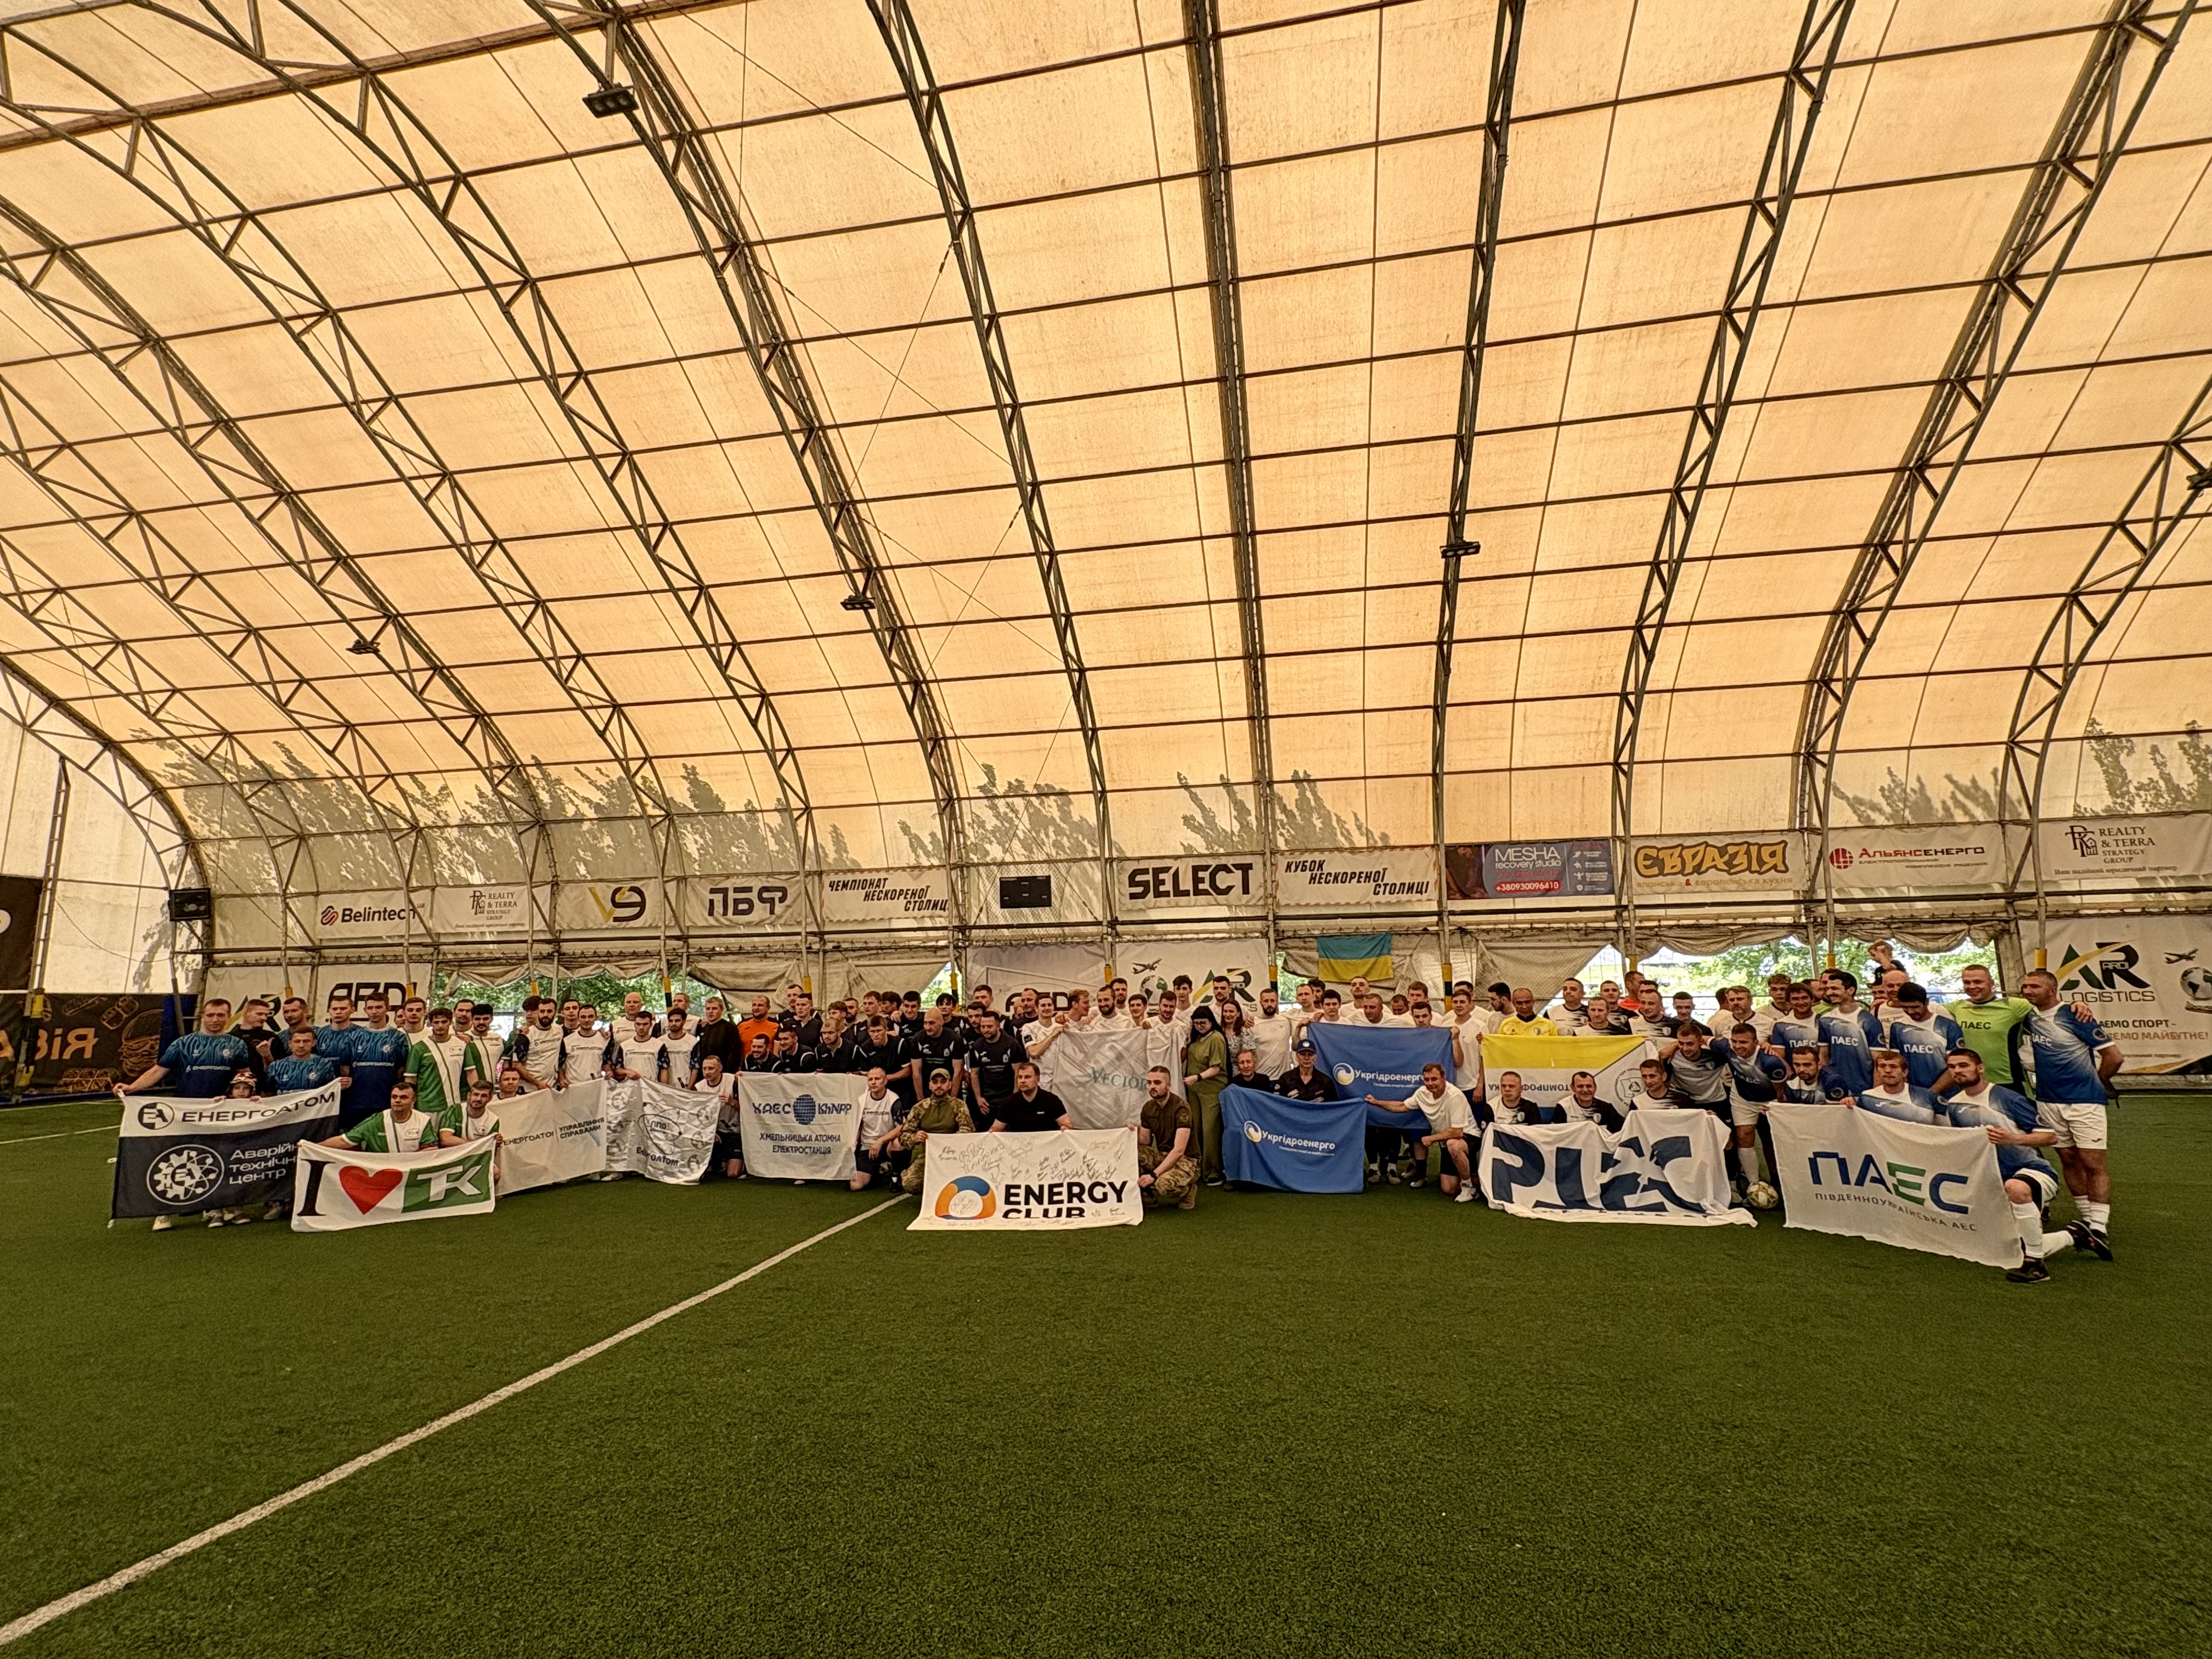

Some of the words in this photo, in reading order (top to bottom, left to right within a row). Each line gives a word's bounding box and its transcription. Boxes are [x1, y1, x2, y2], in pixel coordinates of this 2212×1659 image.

[2098, 826, 2146, 836] REALTY
[2102, 839, 2111, 848] &
[2113, 837, 2155, 848] TERRA
[1495, 847, 1561, 861] MESHA
[1635, 840, 1789, 878] ЄВРАЗІЯ
[1285, 860, 1326, 873] КУБОК
[1495, 861, 1533, 870] recovery
[1535, 859, 1561, 867] studio
[1128, 862, 1254, 900] SELECT
[1308, 868, 1388, 885] НЕСКОРЕНОЇ
[828, 878, 889, 891] ЧЕМПІОНАТ
[1373, 881, 1430, 895] СТОЛИЦІ
[863, 885, 931, 901] НЕСКОРЕНОЇ
[904, 899, 949, 912] СТОЛИЦ
[2059, 991, 2155, 1003] LOGISTICS
[1961, 1020, 1991, 1030] ПАЕС
[2132, 1019, 2170, 1028] СПОРТ
[1831, 1036, 1859, 1047] ПАЕС
[1904, 1043, 1934, 1054] ПАЕС
[181, 1091, 336, 1122] ЕНЕРГОАТОМ
[560, 1125, 601, 1139] СПРАВАМИ
[759, 1132, 813, 1143] ХМЕЛЬНИЦЬКА
[814, 1133, 841, 1142] АТОМНА
[1262, 1130, 1336, 1150] Укргідроенерго
[229, 1169, 286, 1184] центр
[1808, 1151, 1969, 1215] ПАЕС
[1004, 1180, 1128, 1206] ENERGY
[1952, 1222, 1978, 1231] АЕС
